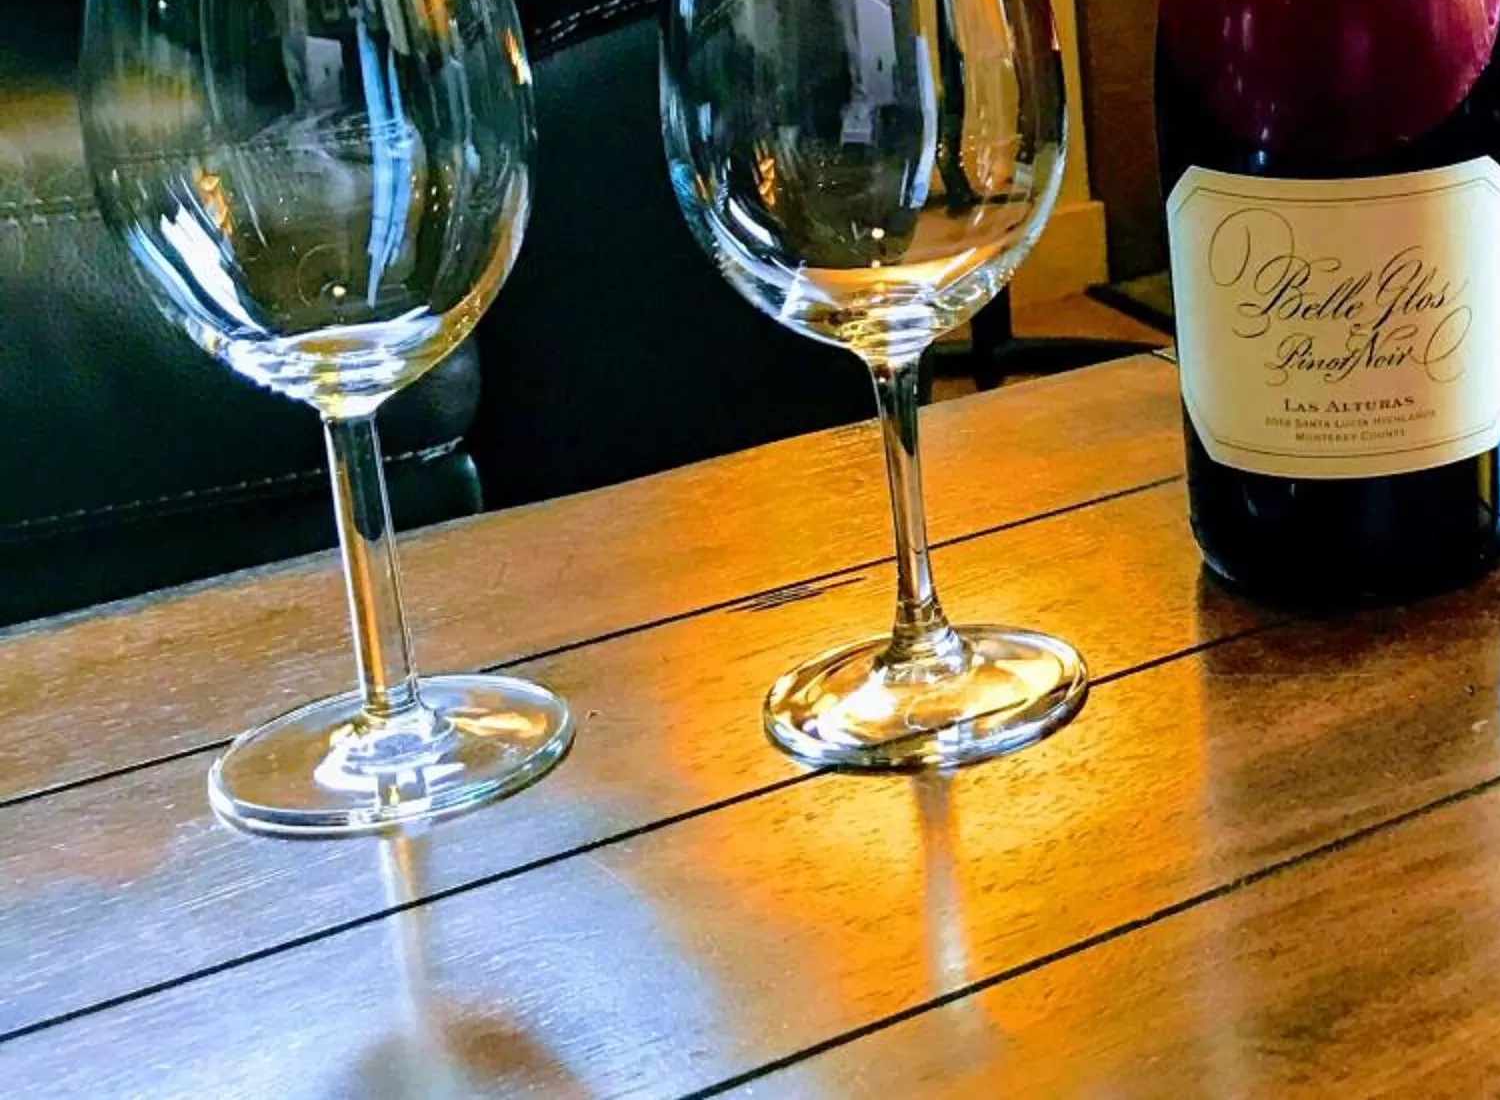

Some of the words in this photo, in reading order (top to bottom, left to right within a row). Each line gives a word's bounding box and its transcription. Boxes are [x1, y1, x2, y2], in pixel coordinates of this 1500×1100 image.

[1353, 245, 1453, 330] Glos
[1268, 332, 1354, 374] Pinot
[1346, 326, 1417, 374] Noir
[1284, 397, 1320, 412] LAS
[1325, 395, 1415, 412] ALTURAS
